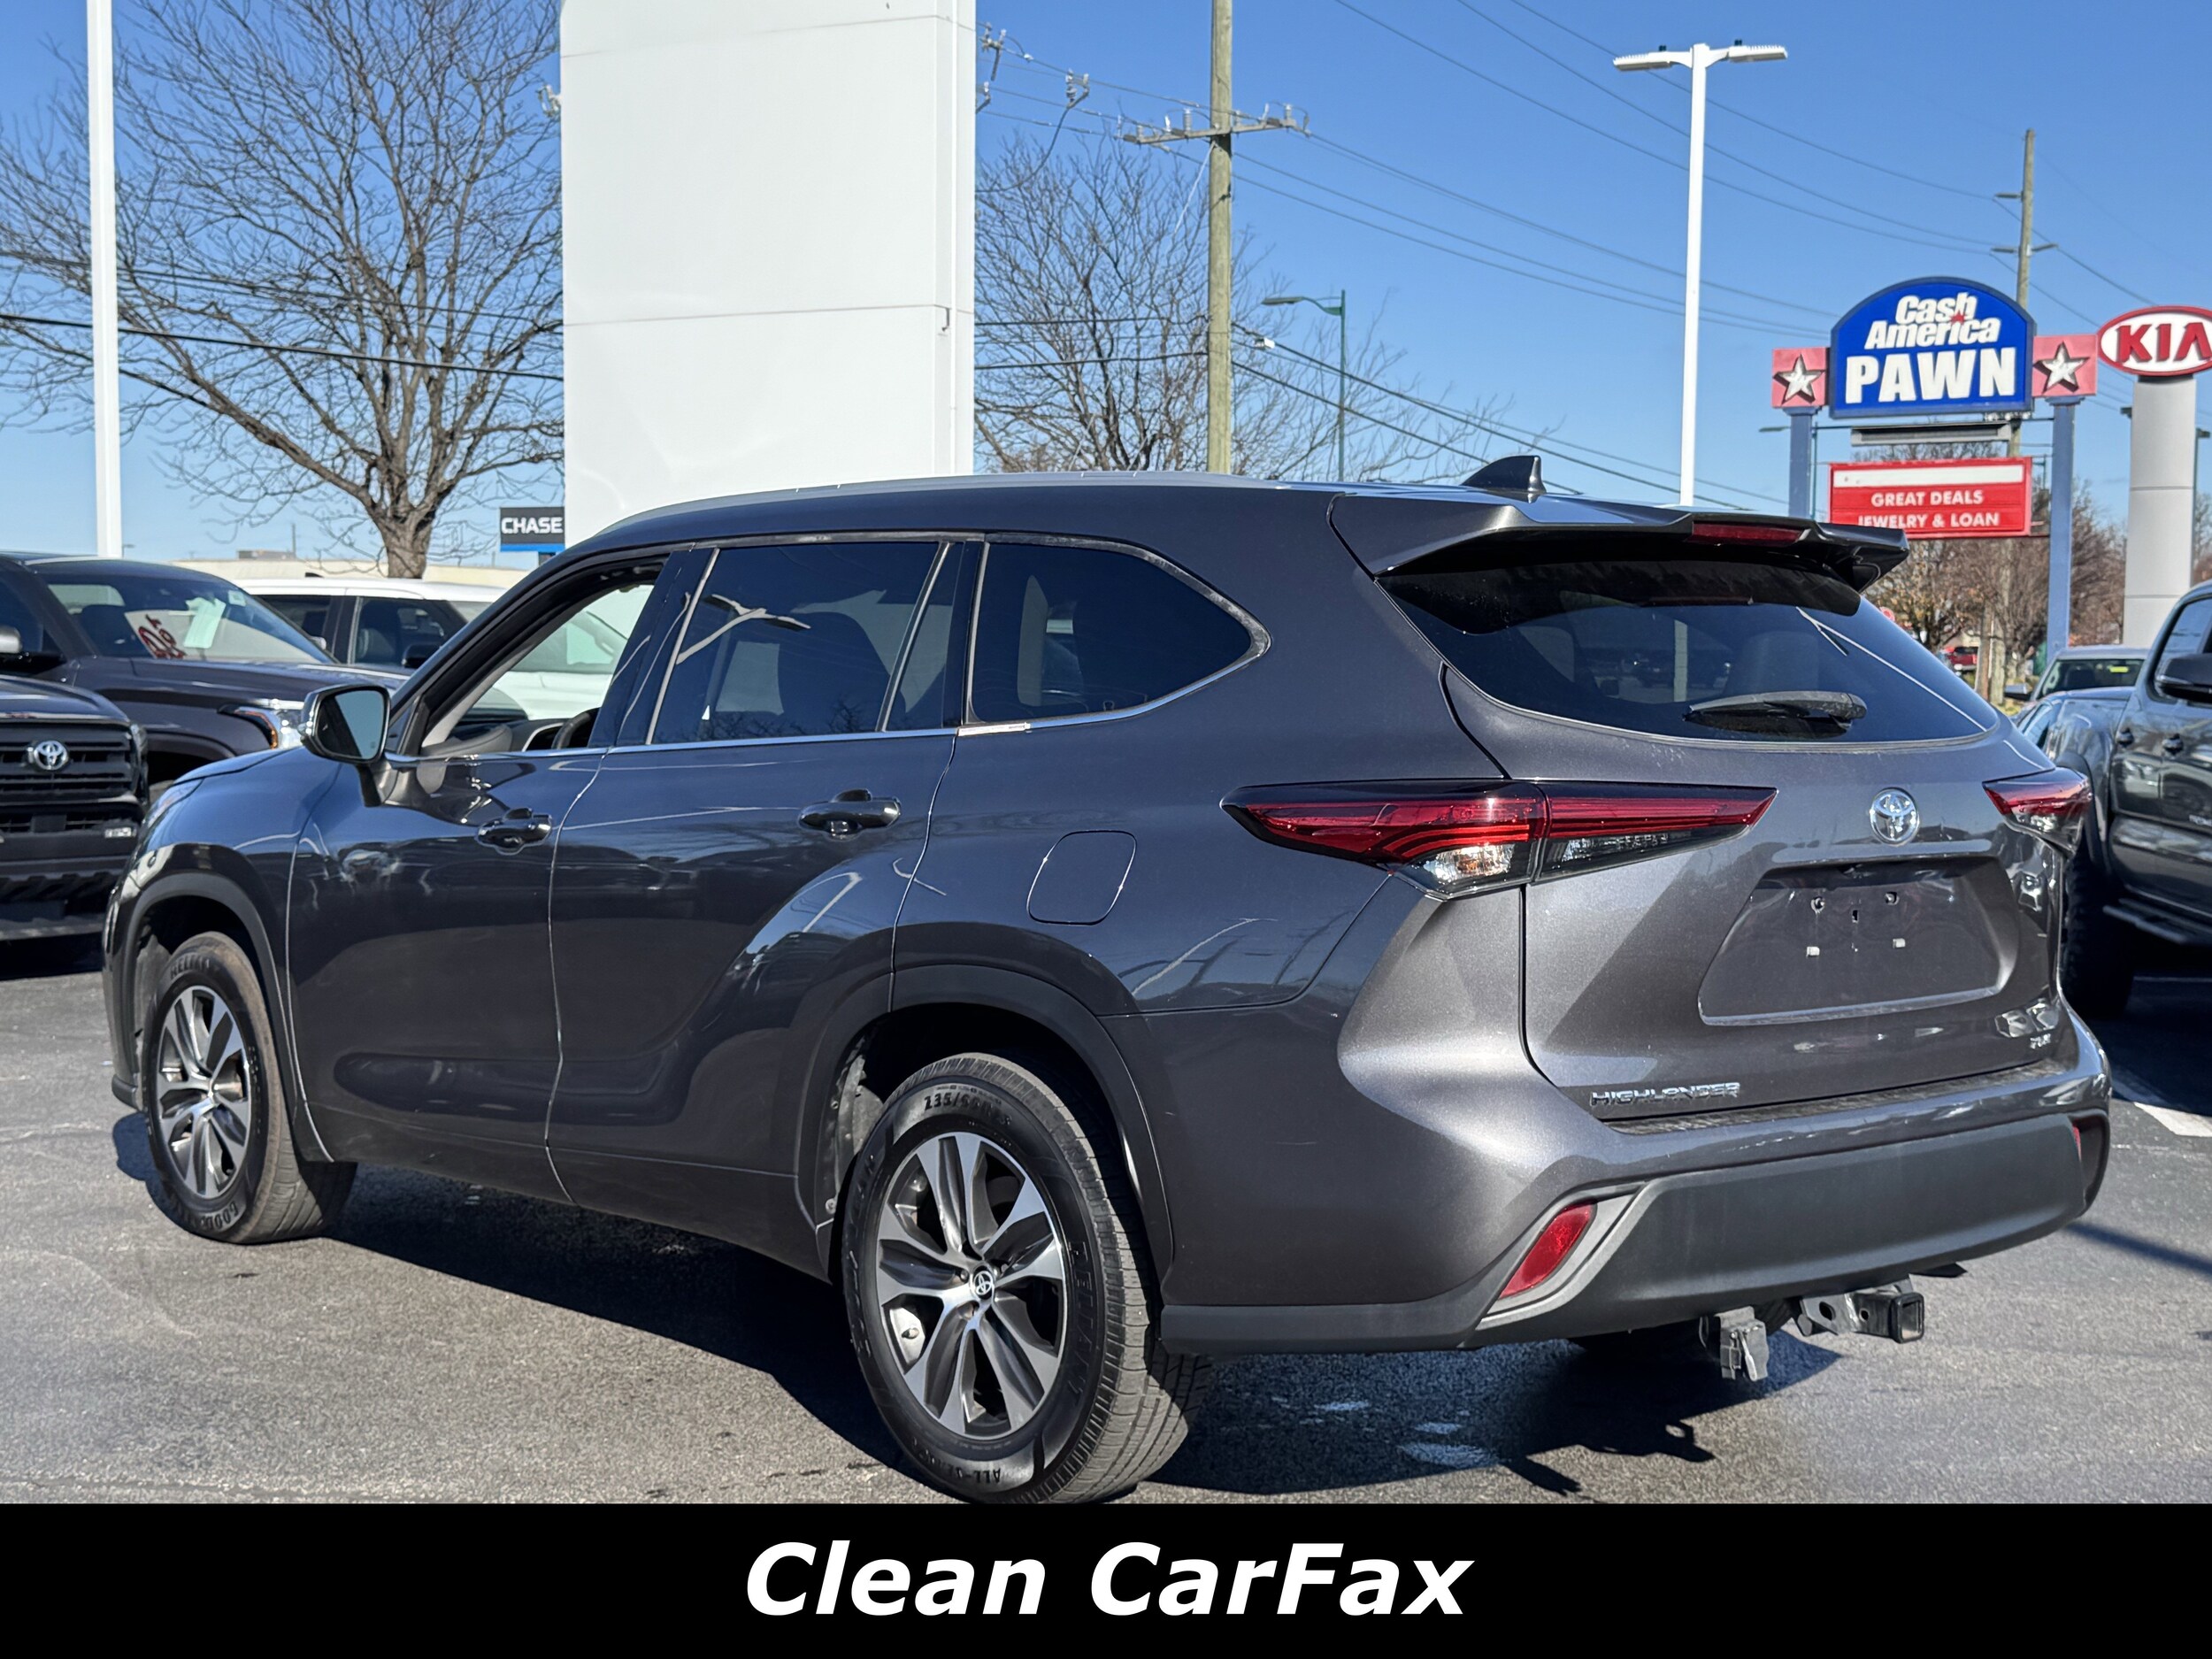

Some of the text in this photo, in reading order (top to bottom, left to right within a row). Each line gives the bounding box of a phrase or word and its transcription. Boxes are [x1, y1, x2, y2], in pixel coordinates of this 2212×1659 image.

[1895, 292, 1978, 326] Cash
[1864, 318, 2001, 349] America
[2116, 322, 2212, 363] KIA
[1846, 347, 2016, 403] PAWN
[1870, 489, 1984, 507] GREAT DEALS
[501, 517, 564, 534] CHASE
[1932, 513, 1945, 528] &
[1950, 511, 2000, 527] LOAN
[1590, 1081, 1741, 1106] HIGHLANDER
